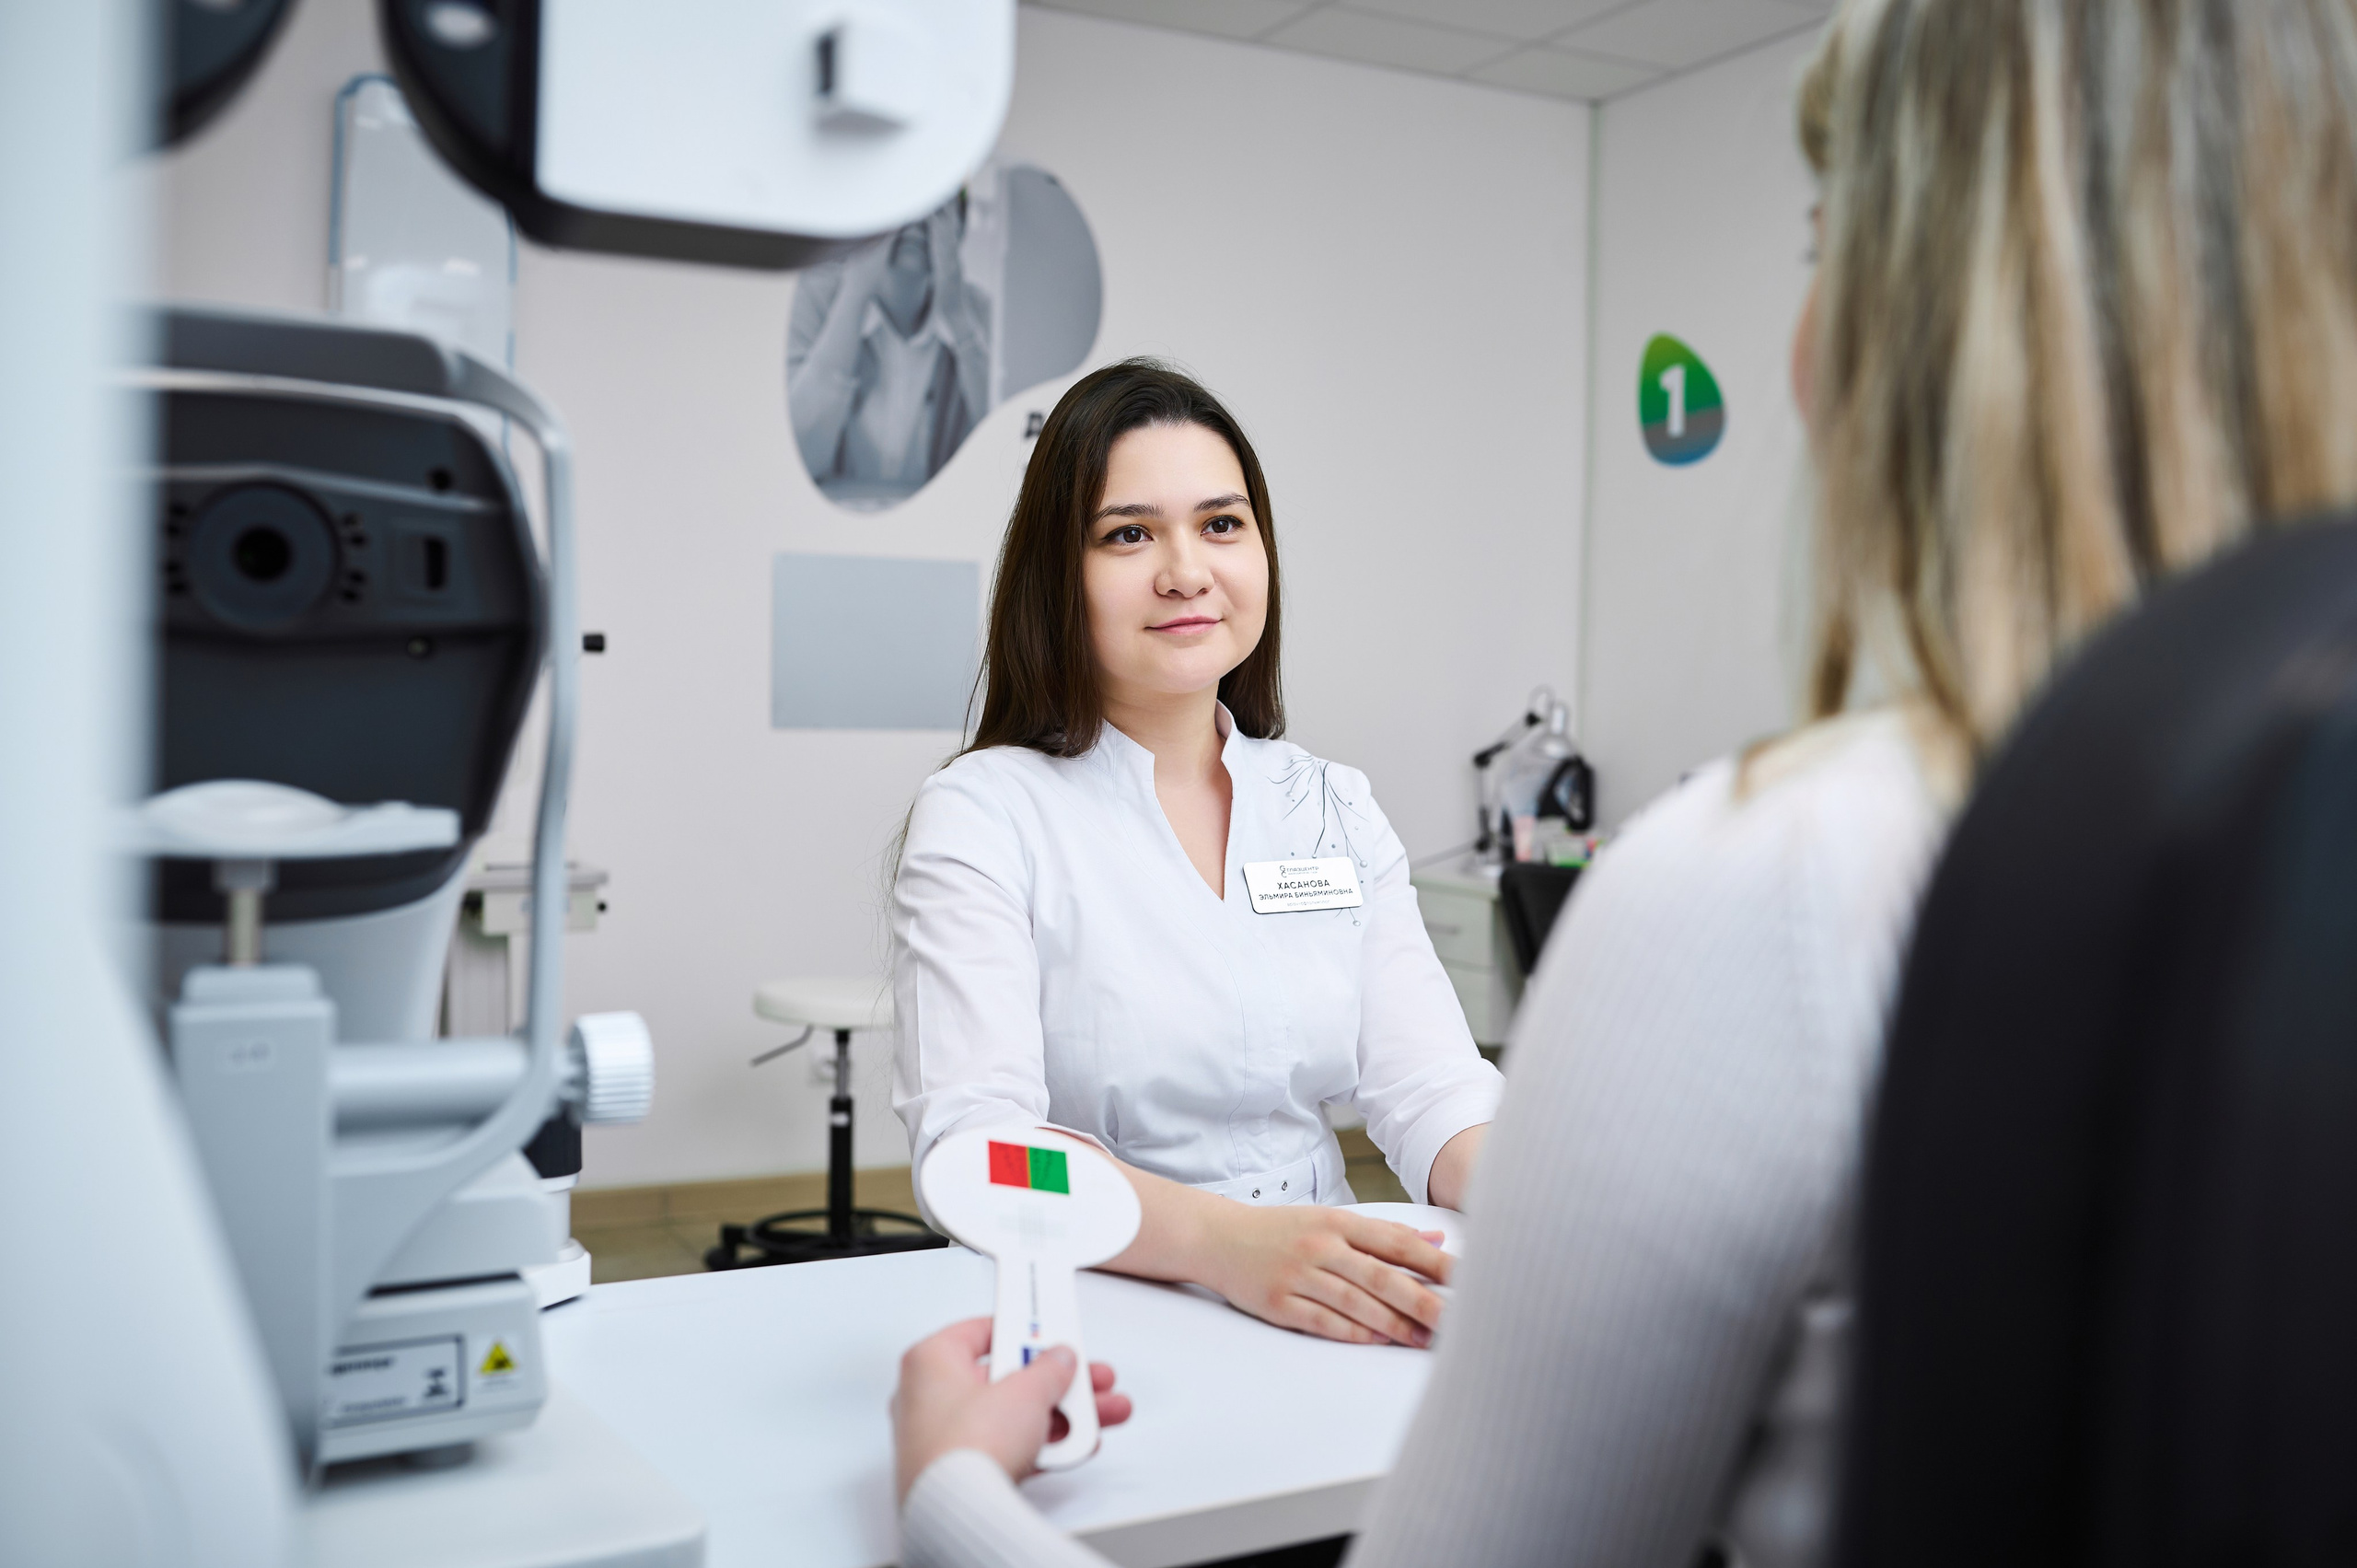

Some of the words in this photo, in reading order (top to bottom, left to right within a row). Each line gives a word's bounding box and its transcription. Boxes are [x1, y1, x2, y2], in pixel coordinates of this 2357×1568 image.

[1659, 364, 1686, 439] 1
[1277, 879, 1330, 889] ХАСАНОВА
[1259, 892, 1294, 900] ЭЛЬМИРА
[1295, 889, 1353, 899] БИНЬЯМИНОВНА
